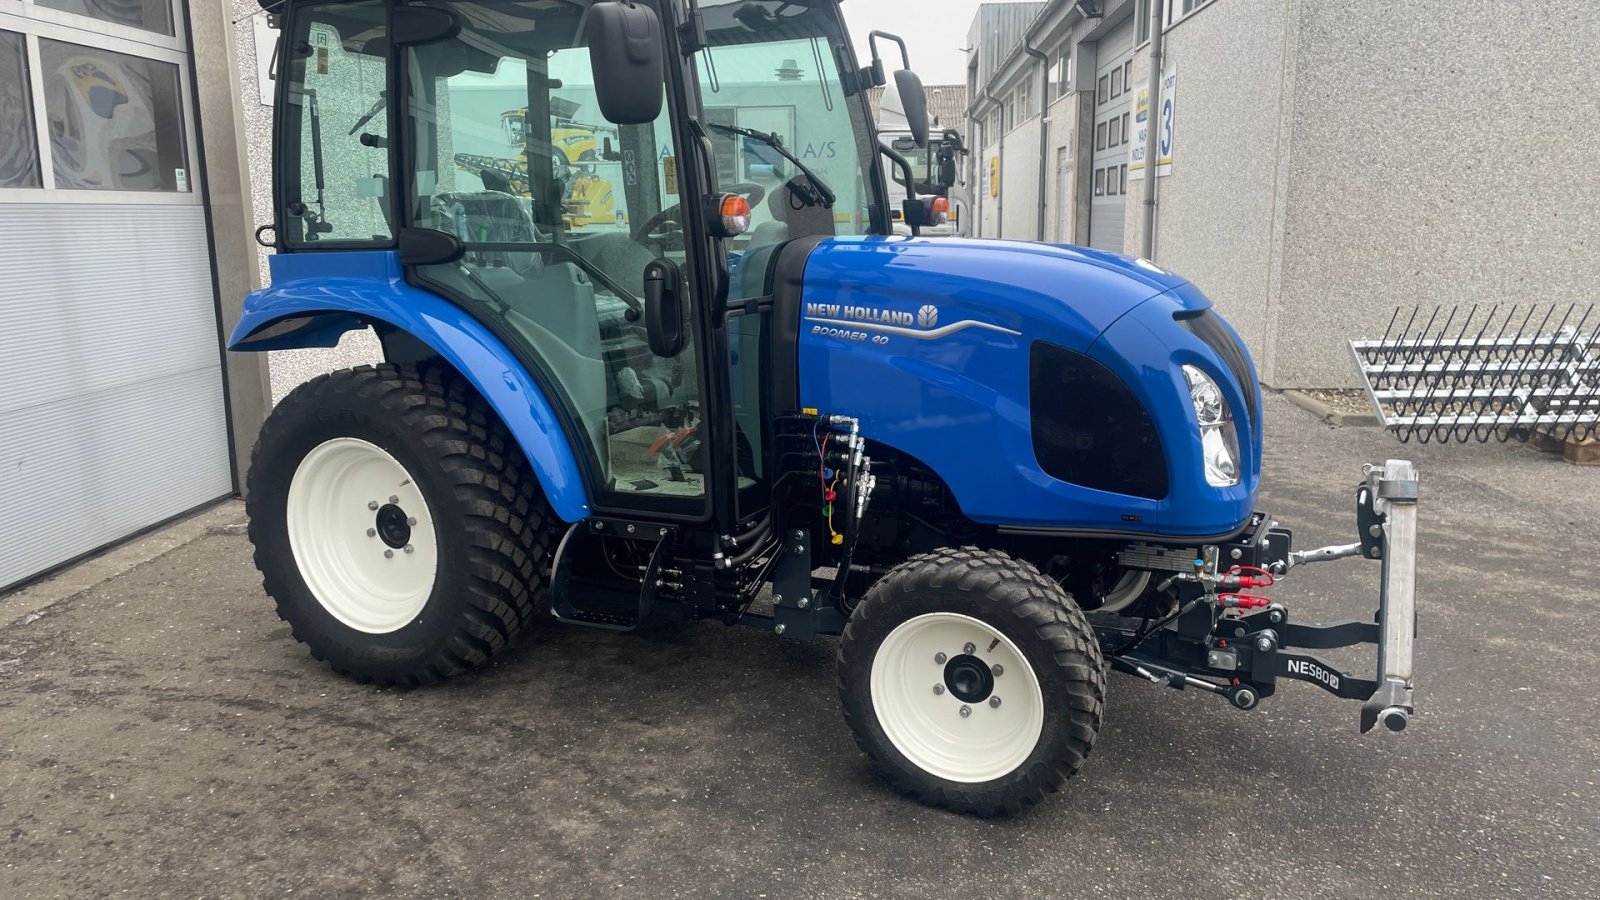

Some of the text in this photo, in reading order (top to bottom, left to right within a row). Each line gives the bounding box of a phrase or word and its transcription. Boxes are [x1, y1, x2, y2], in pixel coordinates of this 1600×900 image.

[1162, 98, 1172, 156] 3
[803, 141, 836, 159] A/S
[807, 303, 914, 326] NEW HOLLAND
[812, 325, 889, 345] BOOMER 40
